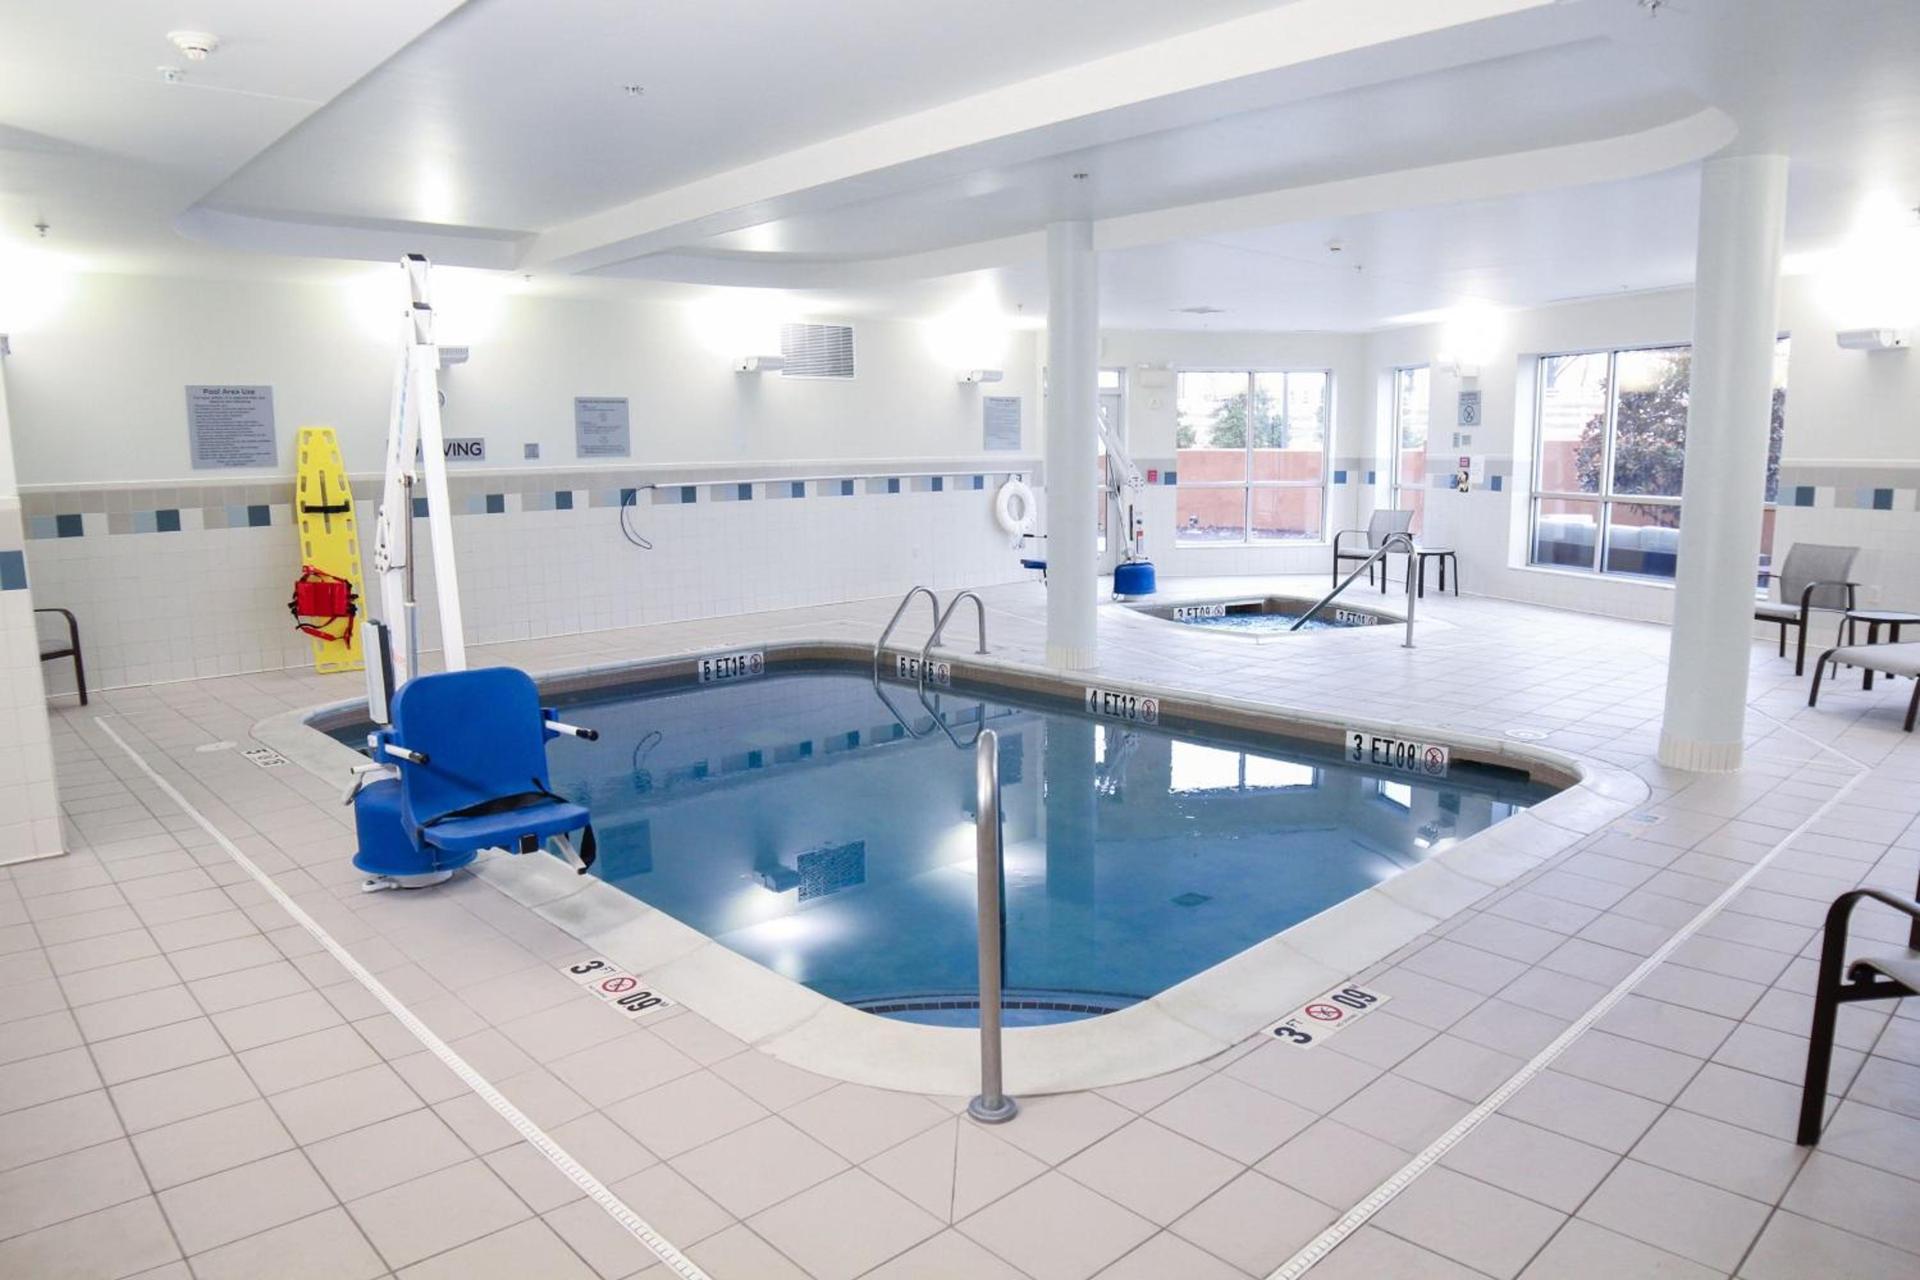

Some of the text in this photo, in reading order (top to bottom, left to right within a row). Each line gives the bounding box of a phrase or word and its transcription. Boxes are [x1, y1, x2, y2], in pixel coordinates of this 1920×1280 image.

[443, 442, 483, 457] VING
[570, 960, 605, 975] 3
[617, 991, 662, 1012] 09
[1331, 988, 1378, 1009] 09
[1273, 1026, 1313, 1044] 3
